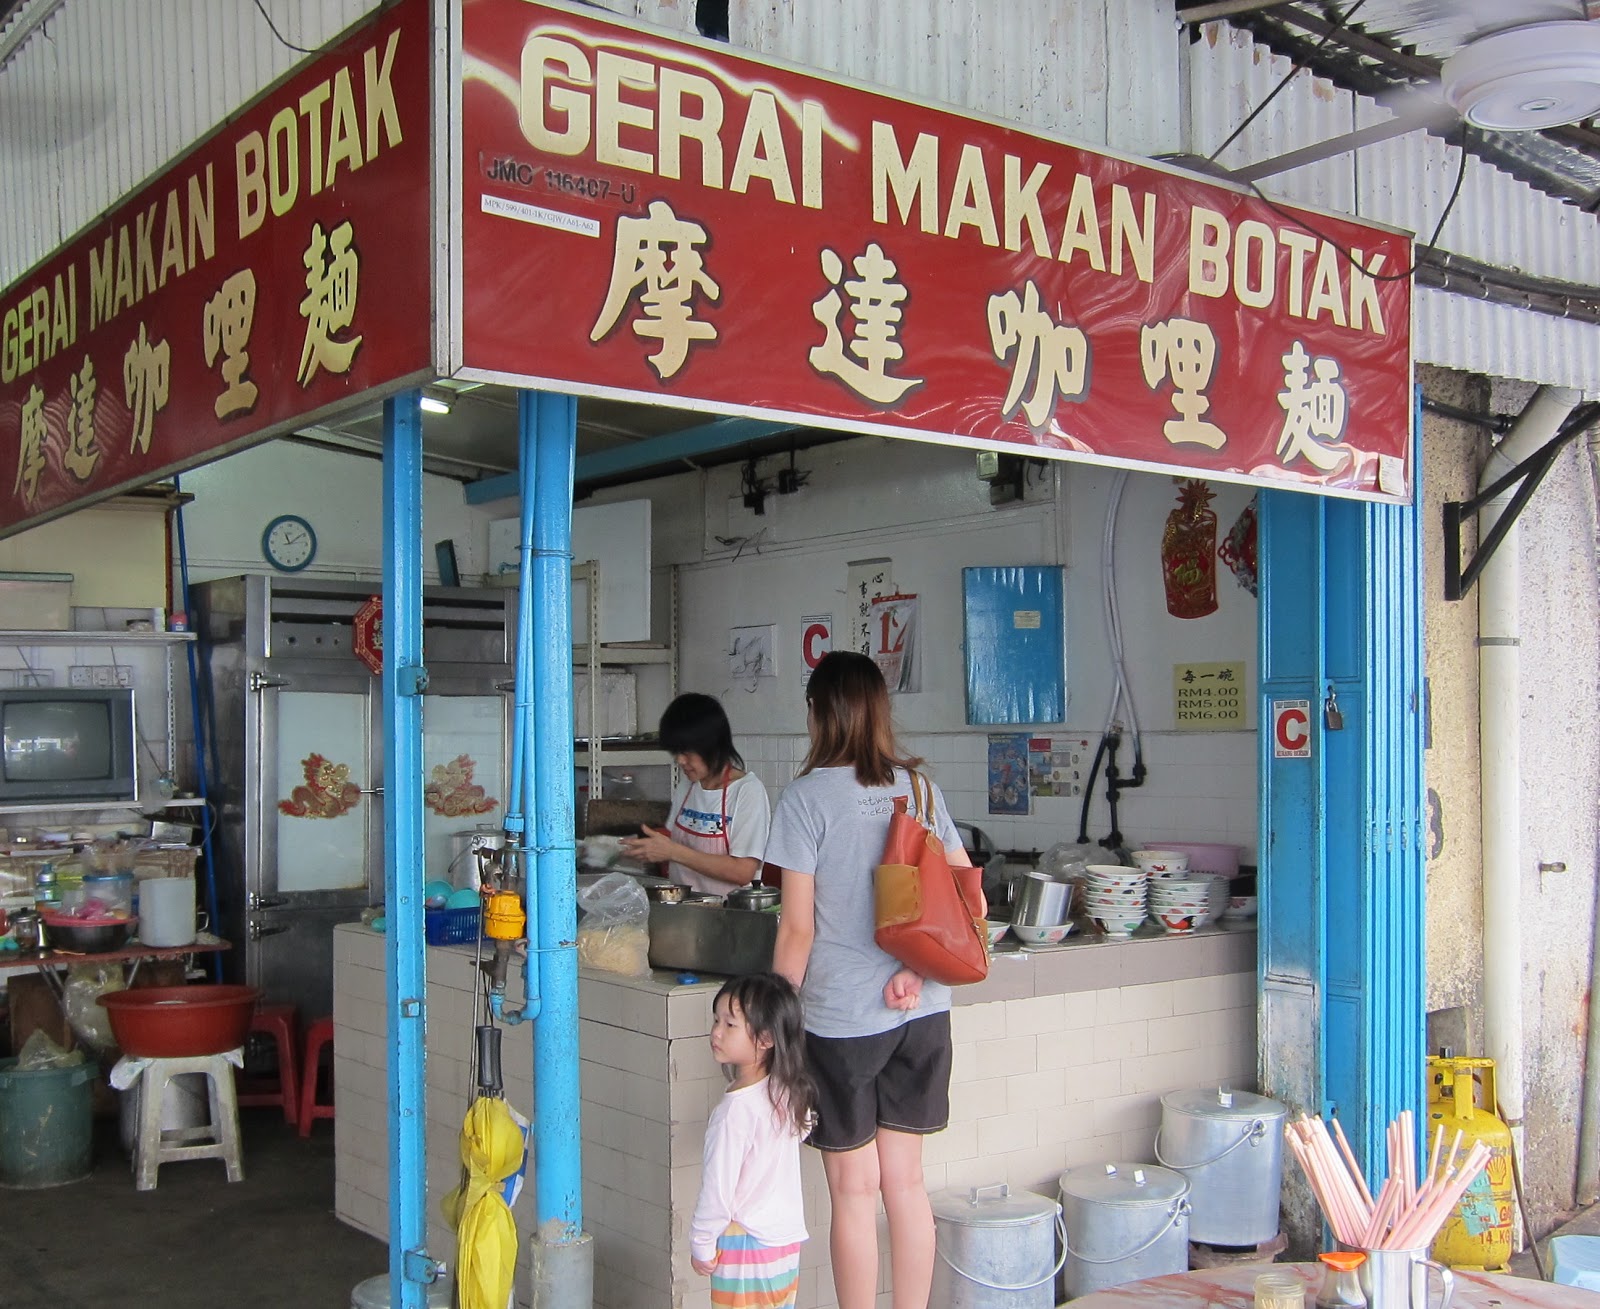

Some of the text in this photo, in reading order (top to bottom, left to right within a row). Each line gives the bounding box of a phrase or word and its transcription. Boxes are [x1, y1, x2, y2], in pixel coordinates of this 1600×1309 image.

[487, 159, 533, 185] JMC
[520, 36, 1387, 336] GERAI MAKAN BOTAK
[1, 27, 402, 384] GERAI MAKAN BOTAK
[802, 623, 830, 670] C
[1178, 687, 1239, 697] RM4.00
[1178, 698, 1239, 709] RM5.00
[1178, 710, 1239, 720] RM6.00
[1276, 708, 1308, 751] C
